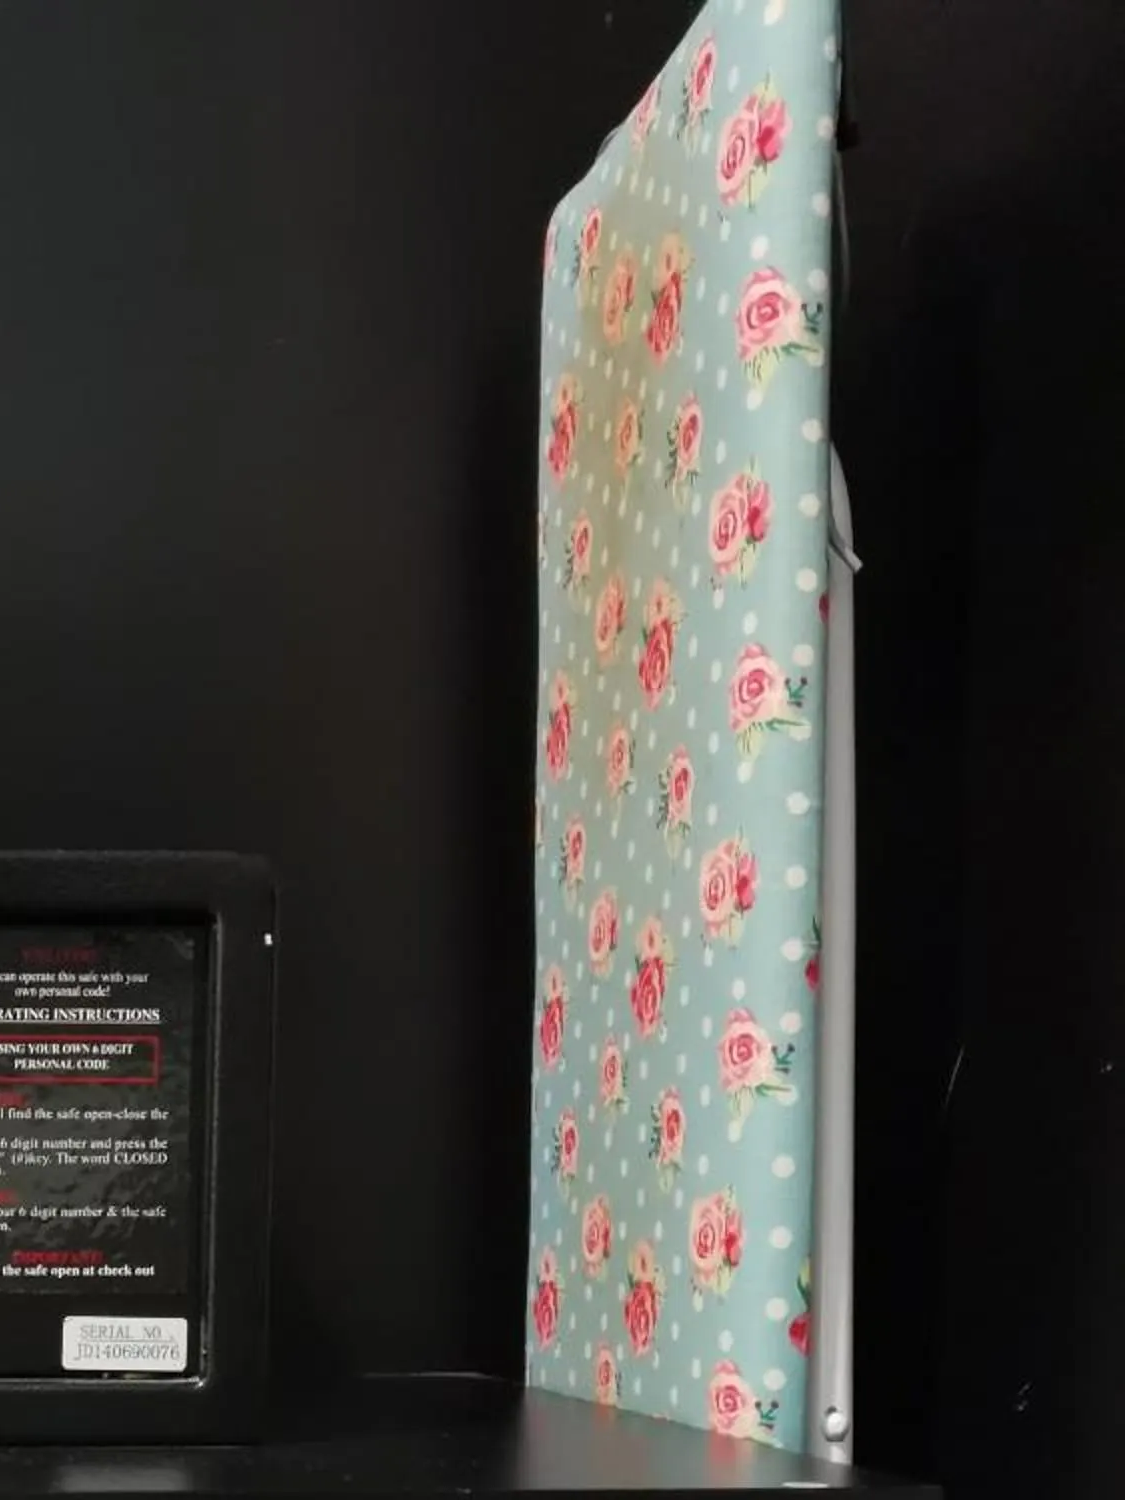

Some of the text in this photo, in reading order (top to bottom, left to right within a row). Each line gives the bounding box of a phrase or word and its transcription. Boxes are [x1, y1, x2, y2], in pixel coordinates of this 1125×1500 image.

[0, 972, 17, 982] can
[19, 972, 56, 984] operate
[58, 970, 76, 982] this
[79, 971, 98, 983] safe
[100, 971, 123, 983] with
[125, 973, 149, 985] your
[15, 986, 111, 999] own personal code!
[53, 1008, 161, 1021] INSTRUCTIONS
[28, 1043, 61, 1055] YOUR
[62, 1043, 89, 1055] OWN
[100, 1043, 134, 1055] DIGIT
[14, 1059, 110, 1070] PERSONAL CODE
[8, 1108, 31, 1119] find
[34, 1108, 53, 1119] the
[56, 1108, 80, 1119] safe
[84, 1108, 146, 1122] open-close
[150, 1108, 169, 1119] the
[0, 1138, 8, 1149] 6
[10, 1138, 38, 1151] digit
[42, 1138, 88, 1149] number
[90, 1138, 112, 1149] and
[114, 1140, 146, 1152] press
[149, 1138, 168, 1149] the
[57, 1153, 76, 1164] The
[81, 1153, 110, 1164] word
[113, 1153, 168, 1164] CLOSED
[18, 1206, 26, 1218] 6
[30, 1206, 57, 1220] digit
[60, 1206, 102, 1218] number
[106, 1206, 117, 1218] &
[121, 1206, 139, 1218] the
[141, 1206, 167, 1218] safe
[2, 1264, 23, 1276] the
[25, 1264, 49, 1276] safe
[50, 1266, 80, 1278] open
[82, 1265, 95, 1276] at
[98, 1264, 132, 1276] check
[135, 1265, 155, 1276] out
[80, 1325, 134, 1339] SERIAL
